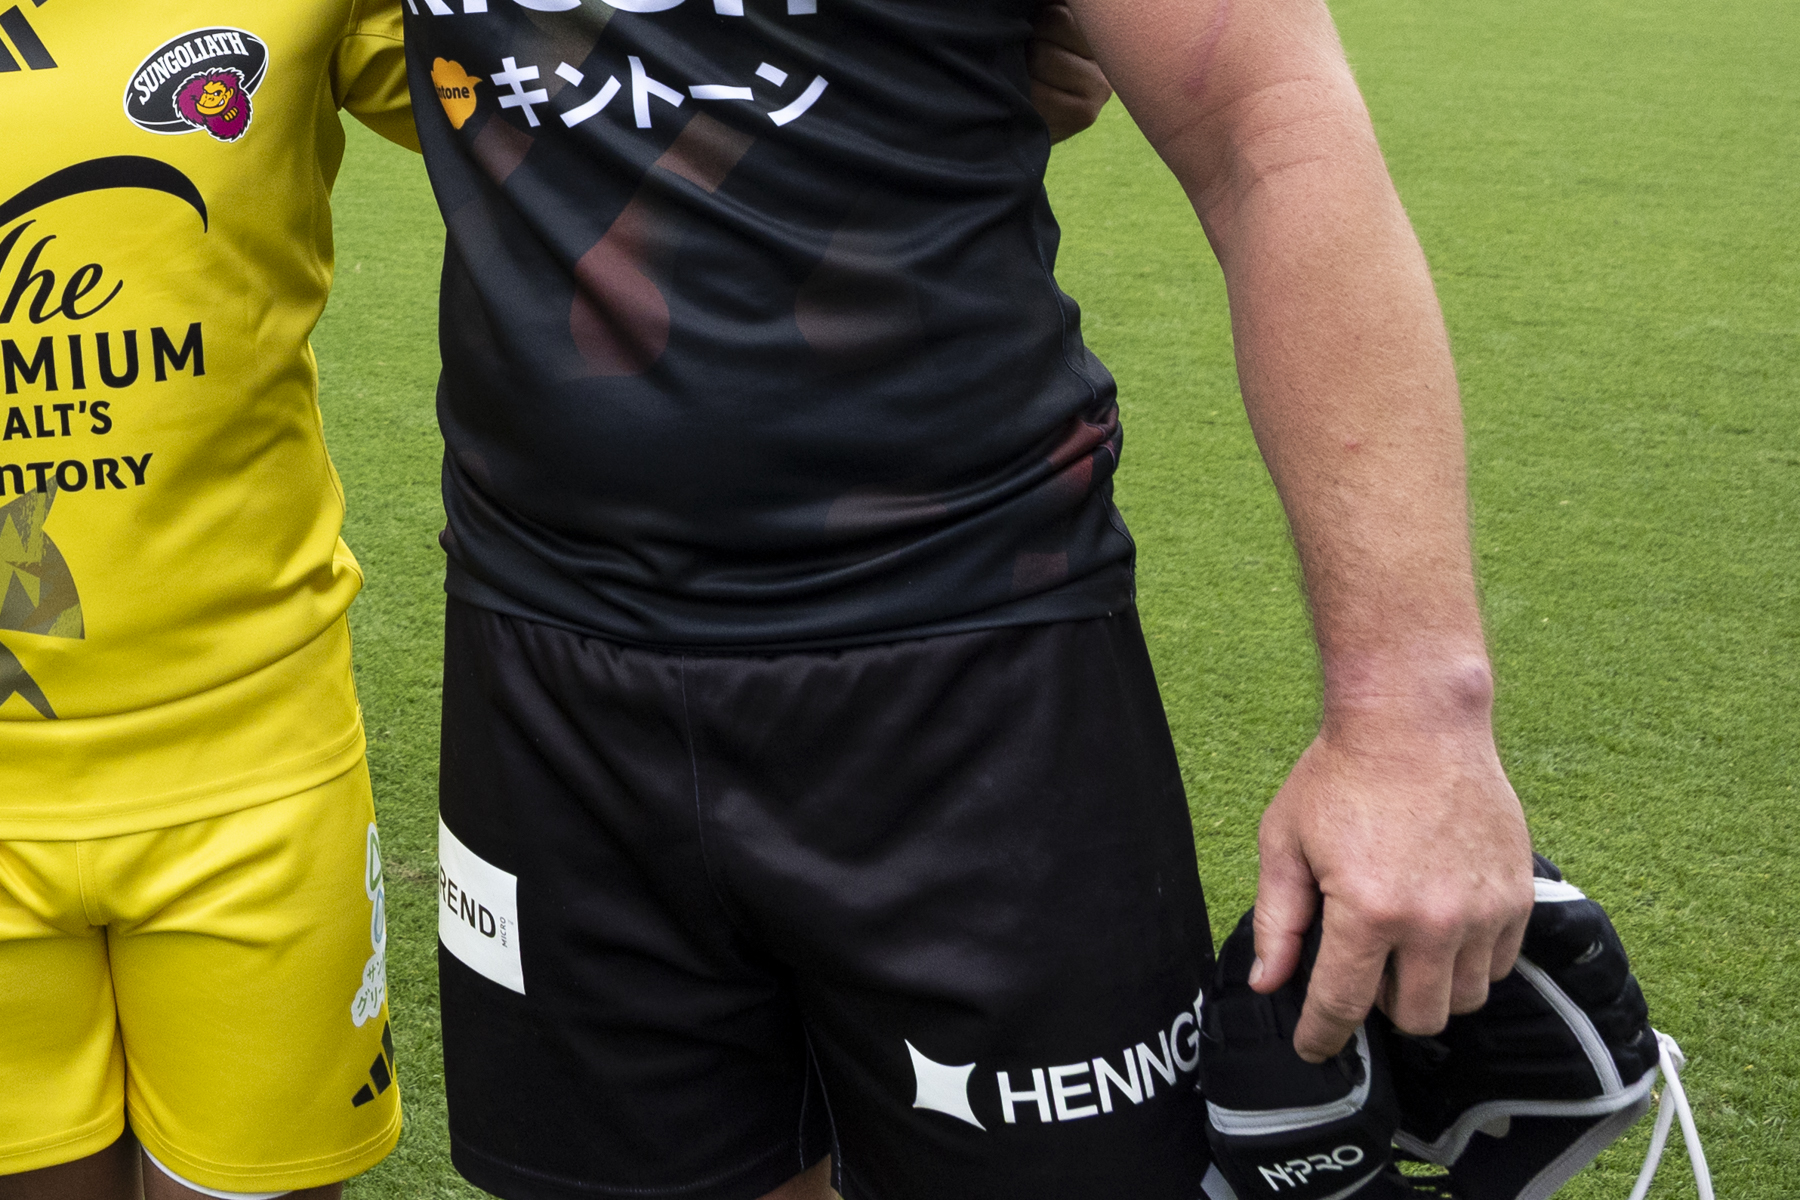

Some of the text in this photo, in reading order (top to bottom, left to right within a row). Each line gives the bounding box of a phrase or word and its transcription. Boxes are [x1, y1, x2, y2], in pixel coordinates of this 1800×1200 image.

[133, 31, 250, 106] SUNGOLIATH
[489, 55, 830, 128] キントーン
